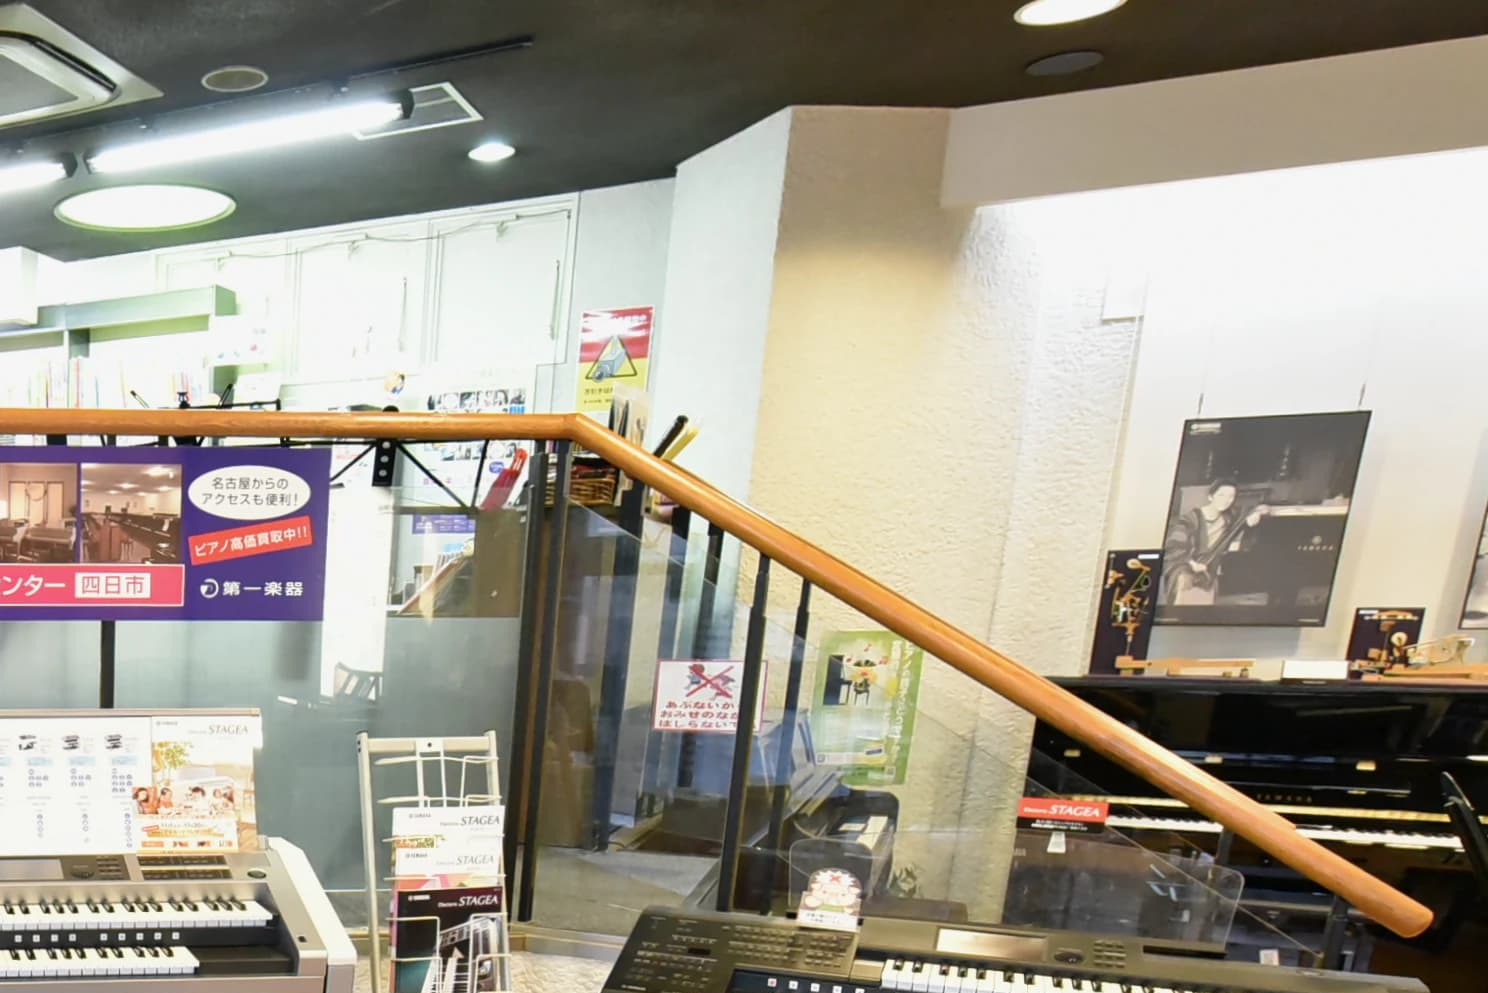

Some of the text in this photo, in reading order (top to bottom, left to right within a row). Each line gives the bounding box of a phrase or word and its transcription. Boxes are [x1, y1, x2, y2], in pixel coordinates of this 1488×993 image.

[212, 477, 289, 490] 名古屋からの
[202, 493, 298, 506] アクセスも便利!
[81, 576, 146, 595] 四日市
[222, 581, 304, 596] 第一楽器
[666, 700, 737, 709] あぶないか
[208, 724, 249, 735] STAGEA
[1048, 804, 1100, 817] STAGEA
[460, 815, 500, 826] STAGEA
[456, 855, 494, 865] STAGEA
[458, 895, 498, 907] STAGEA
